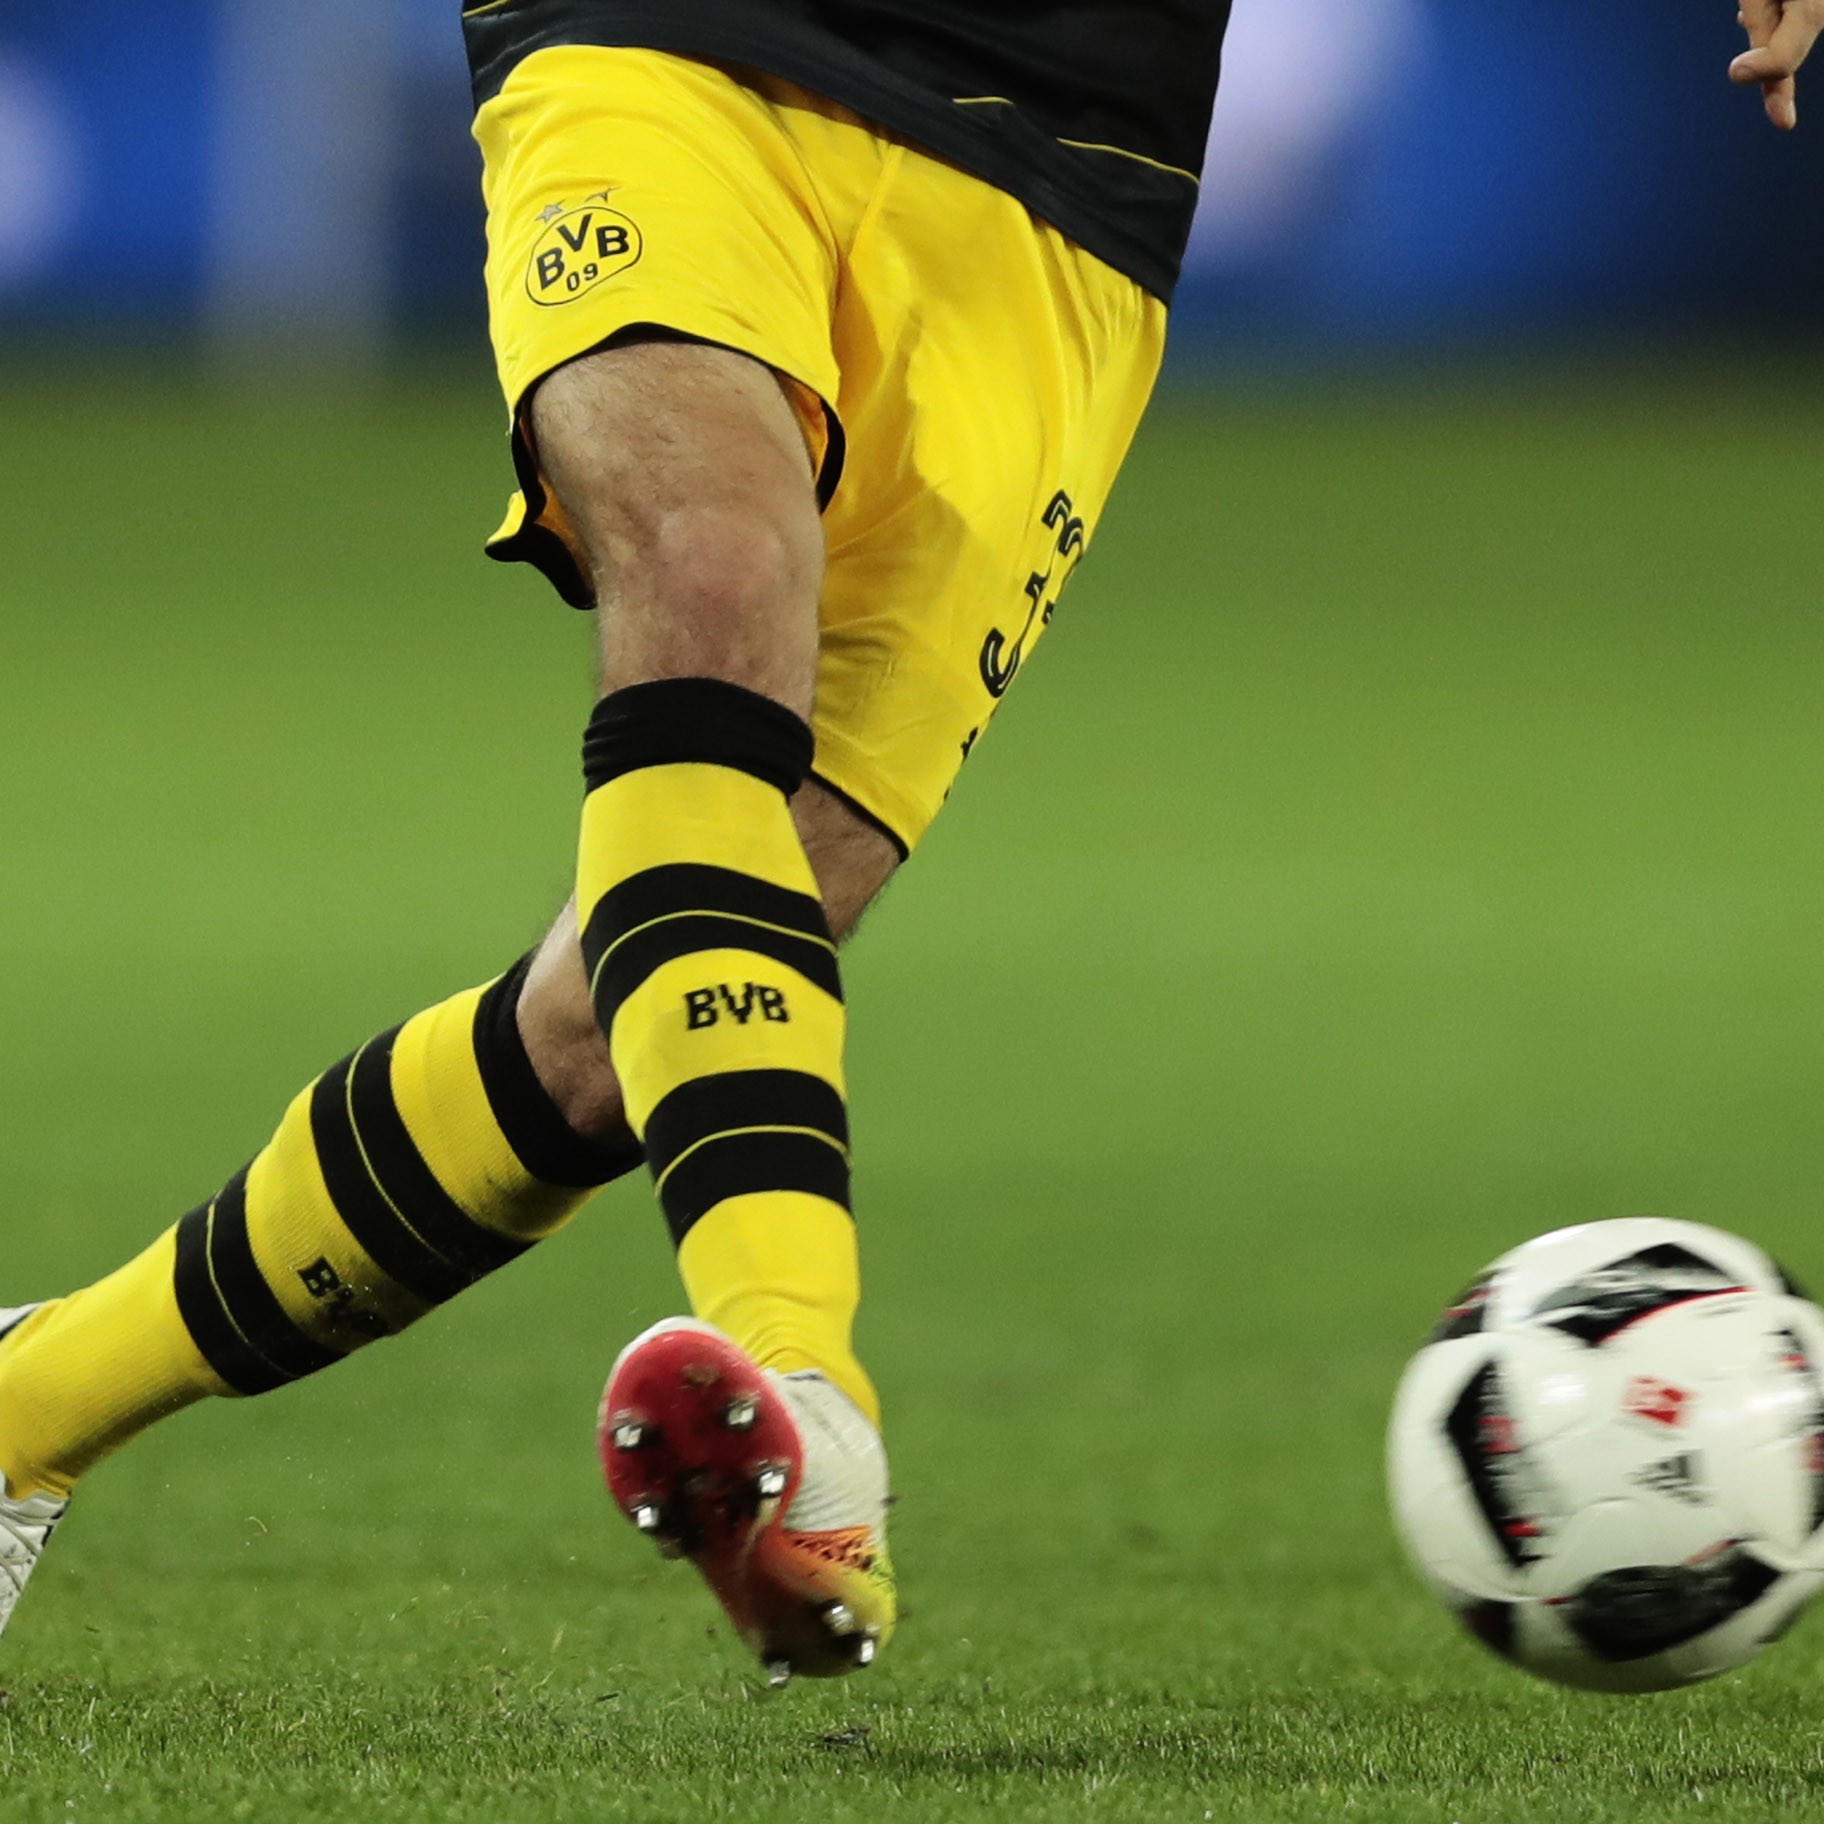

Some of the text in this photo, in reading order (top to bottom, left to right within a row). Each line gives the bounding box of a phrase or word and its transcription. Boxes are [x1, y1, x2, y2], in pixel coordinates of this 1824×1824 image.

[535, 212, 631, 291] BVB
[566, 262, 598, 292] 09
[683, 981, 790, 1031] BVB
